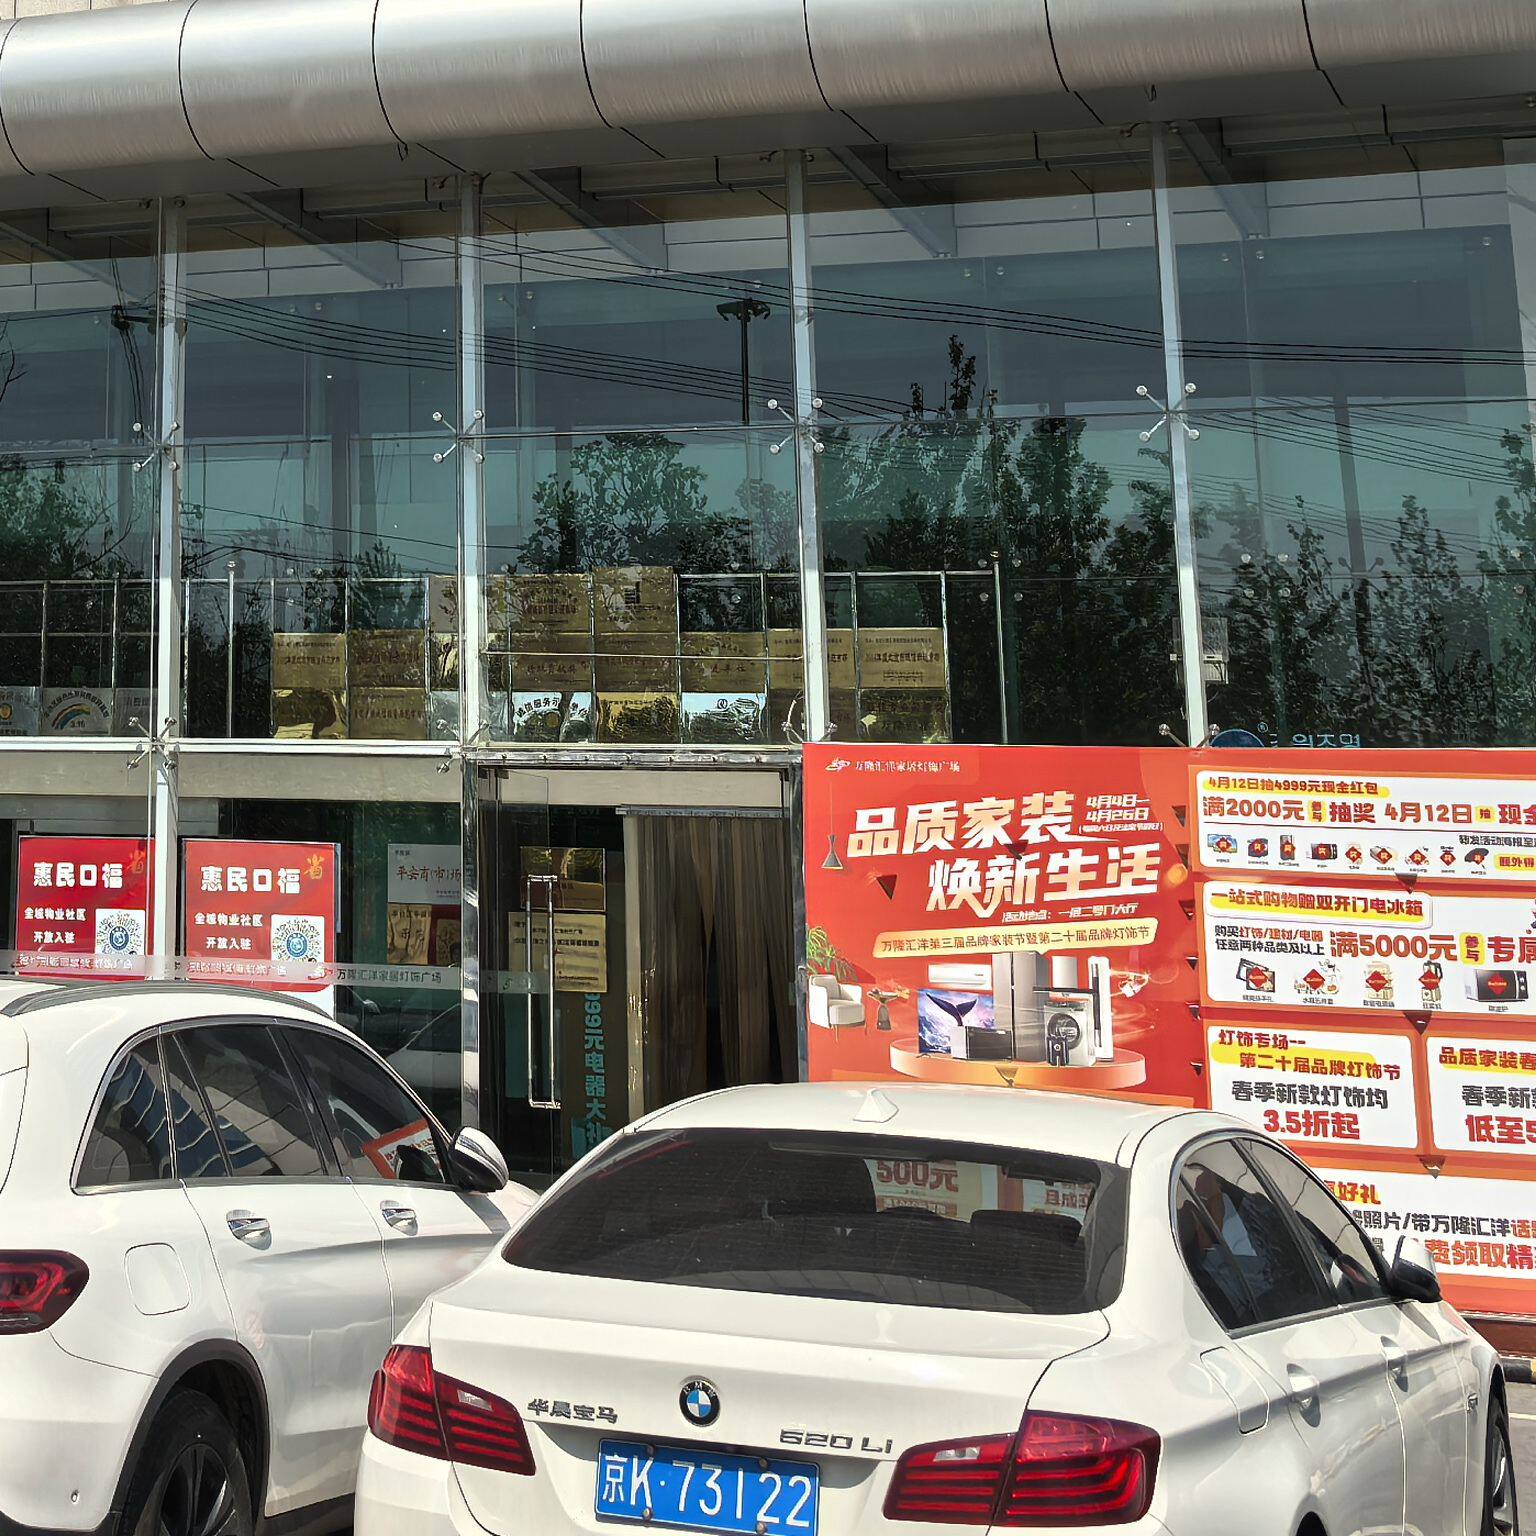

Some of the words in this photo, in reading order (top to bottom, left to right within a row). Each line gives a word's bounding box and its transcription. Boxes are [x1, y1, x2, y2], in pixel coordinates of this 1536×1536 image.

[847, 791, 1076, 858] 品质家装
[33, 862, 123, 889] 惠民口福
[200, 866, 301, 894] 惠民口福
[926, 843, 1161, 918] 焕新生活
[1330, 930, 1458, 962] 满5000元
[1240, 1052, 1401, 1080] 第二十届品牌灯饰节
[1232, 1081, 1388, 1109] 春季新款灯饰均
[1462, 1084, 1536, 1109] 春季新
[1263, 1110, 1360, 1140] 3.5折起
[1352, 1210, 1536, 1239] 照片/带万隆汇洋话
[527, 1398, 618, 1424] 华晨宝马
